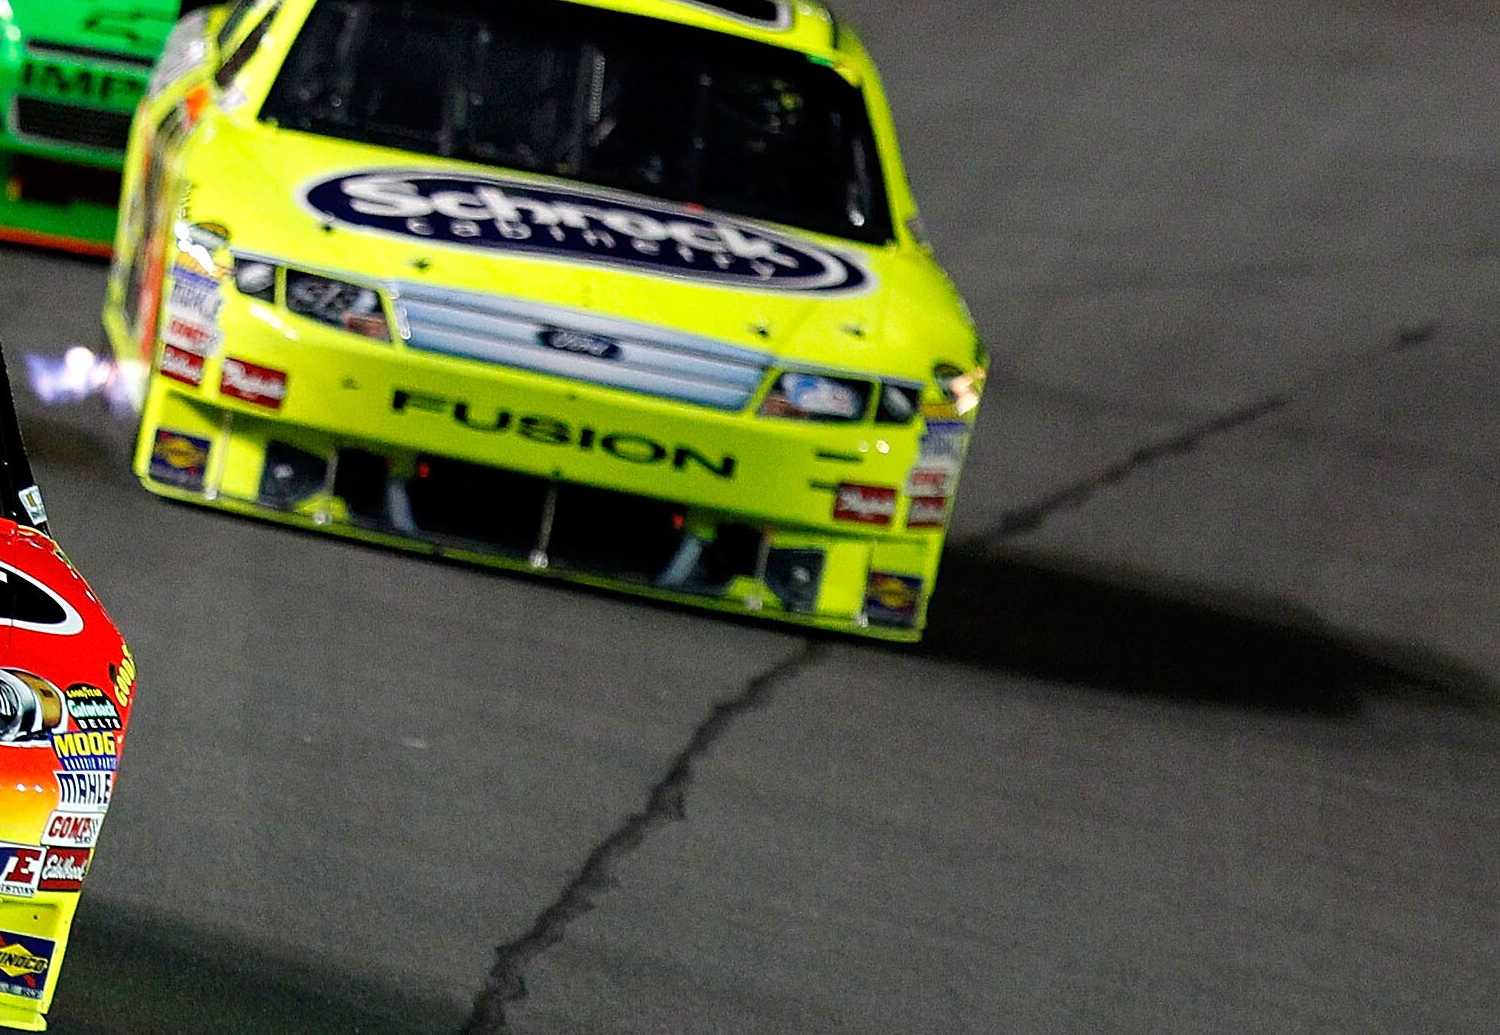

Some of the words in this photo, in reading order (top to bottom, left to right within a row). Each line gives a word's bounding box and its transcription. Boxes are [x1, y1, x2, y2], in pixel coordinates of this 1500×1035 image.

[341, 175, 800, 269] Schrock
[392, 388, 738, 481] FUSION
[53, 731, 116, 758] MOOG
[56, 773, 112, 804] MAHLE
